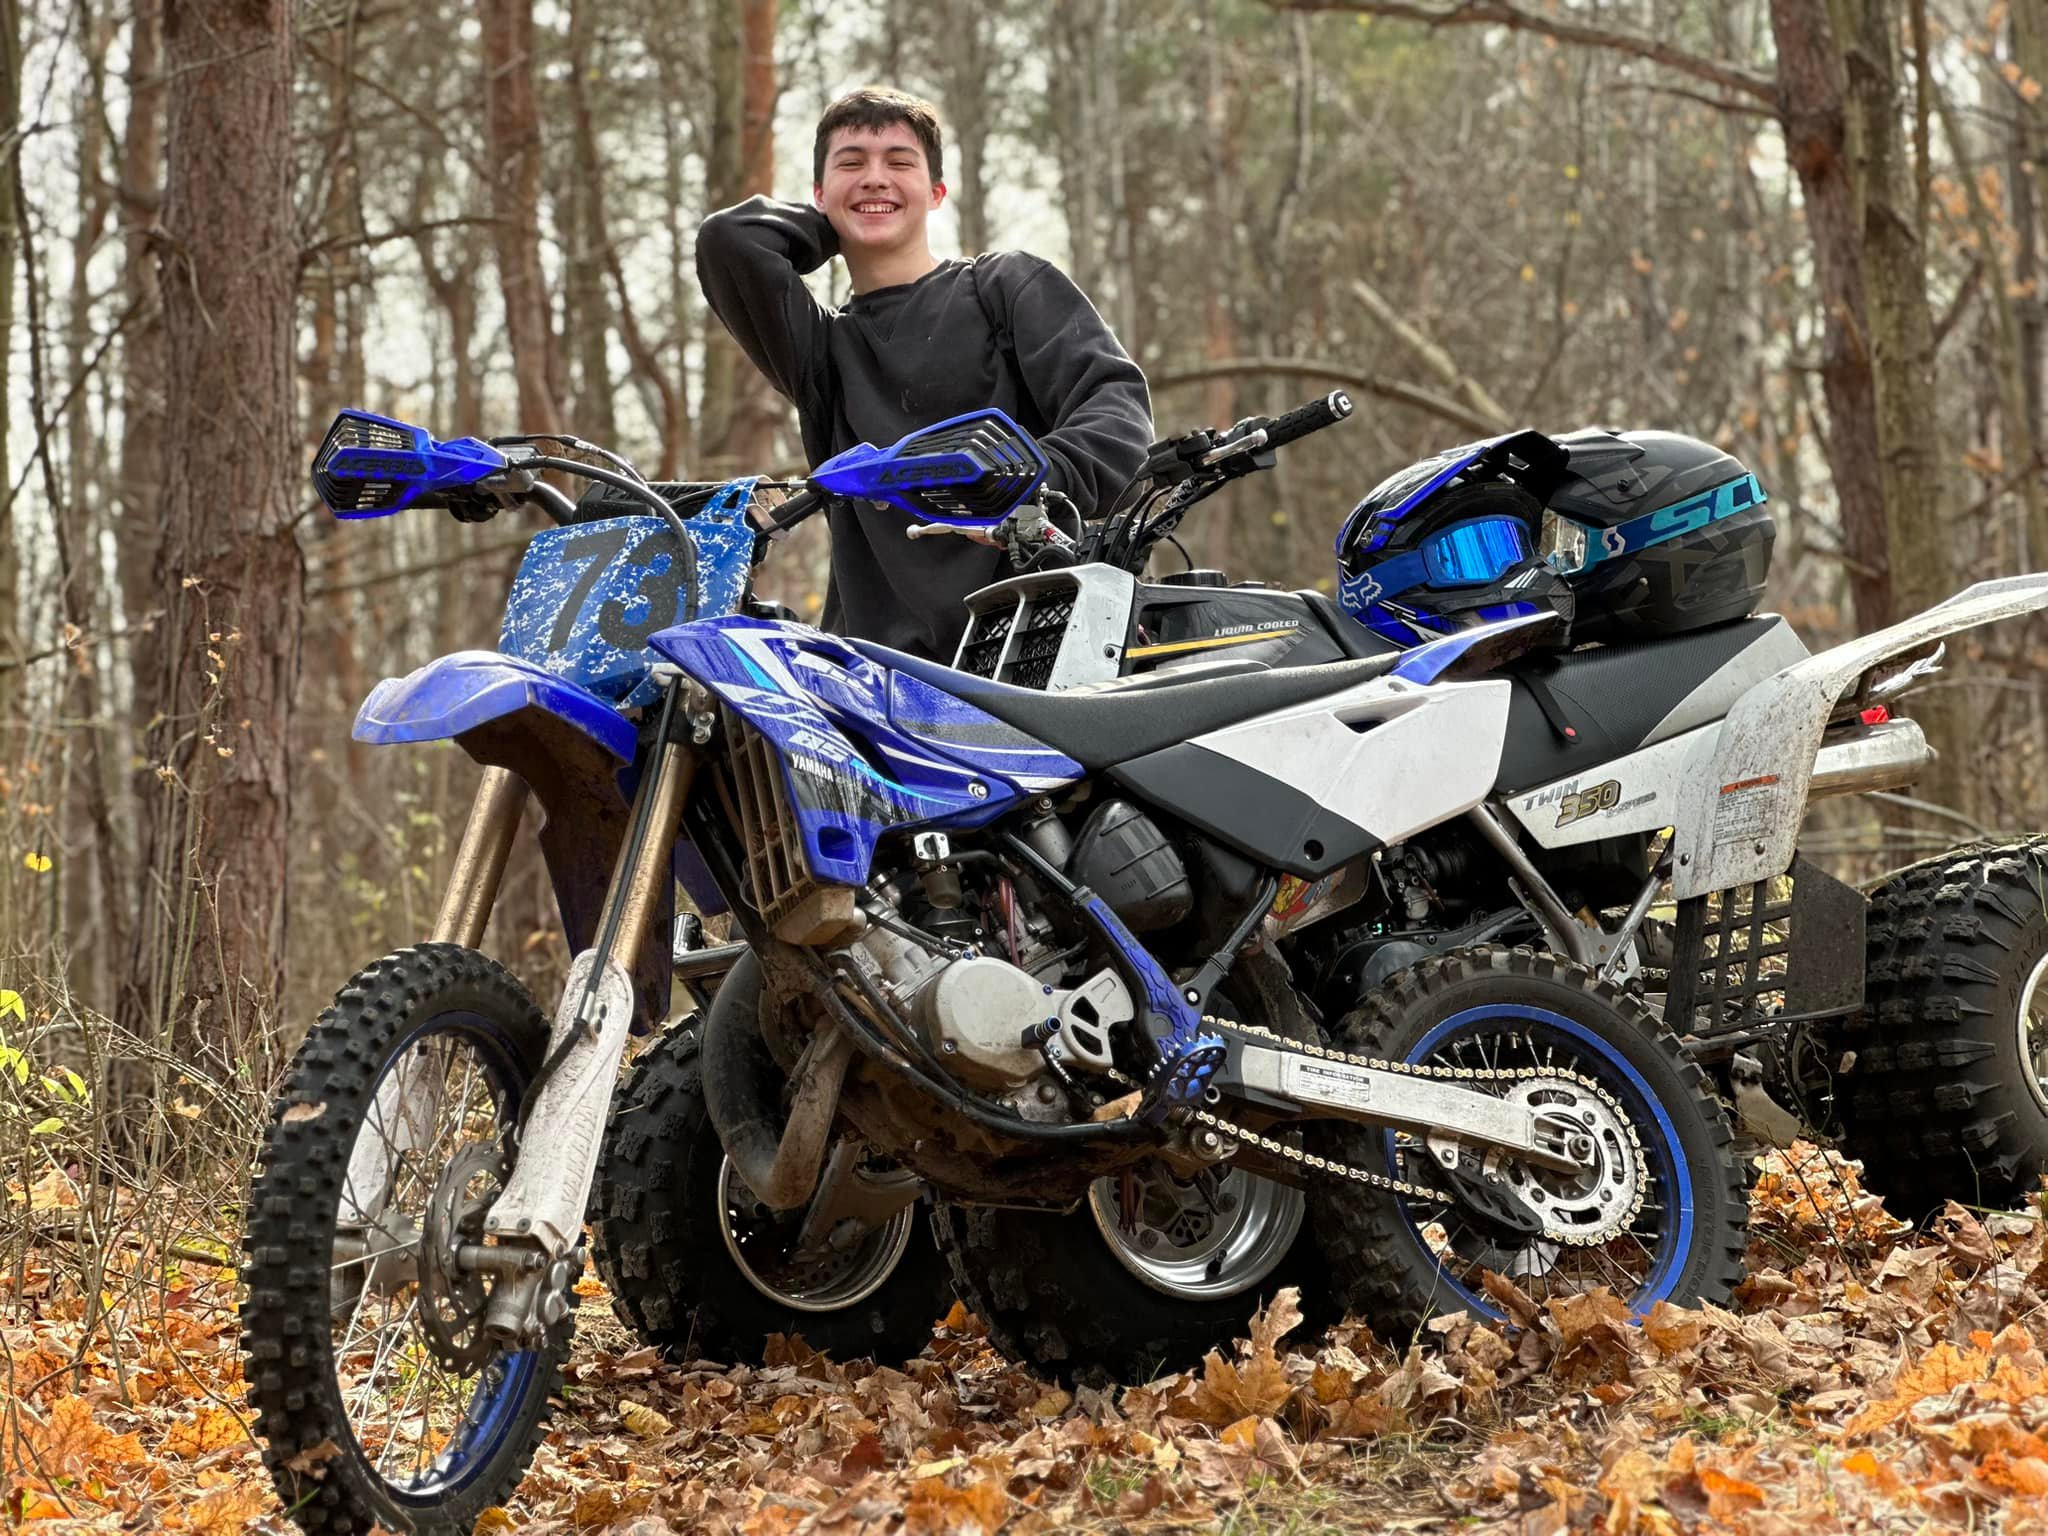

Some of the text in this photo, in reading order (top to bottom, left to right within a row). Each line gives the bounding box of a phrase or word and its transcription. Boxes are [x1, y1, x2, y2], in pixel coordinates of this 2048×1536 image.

[548, 527, 689, 652] 73
[1214, 620, 1299, 637] LIQUID COOLED
[787, 730, 849, 763] 85
[791, 752, 834, 782] YAMAHA
[1523, 780, 1579, 811] TWIN
[1555, 779, 1621, 828] 350
